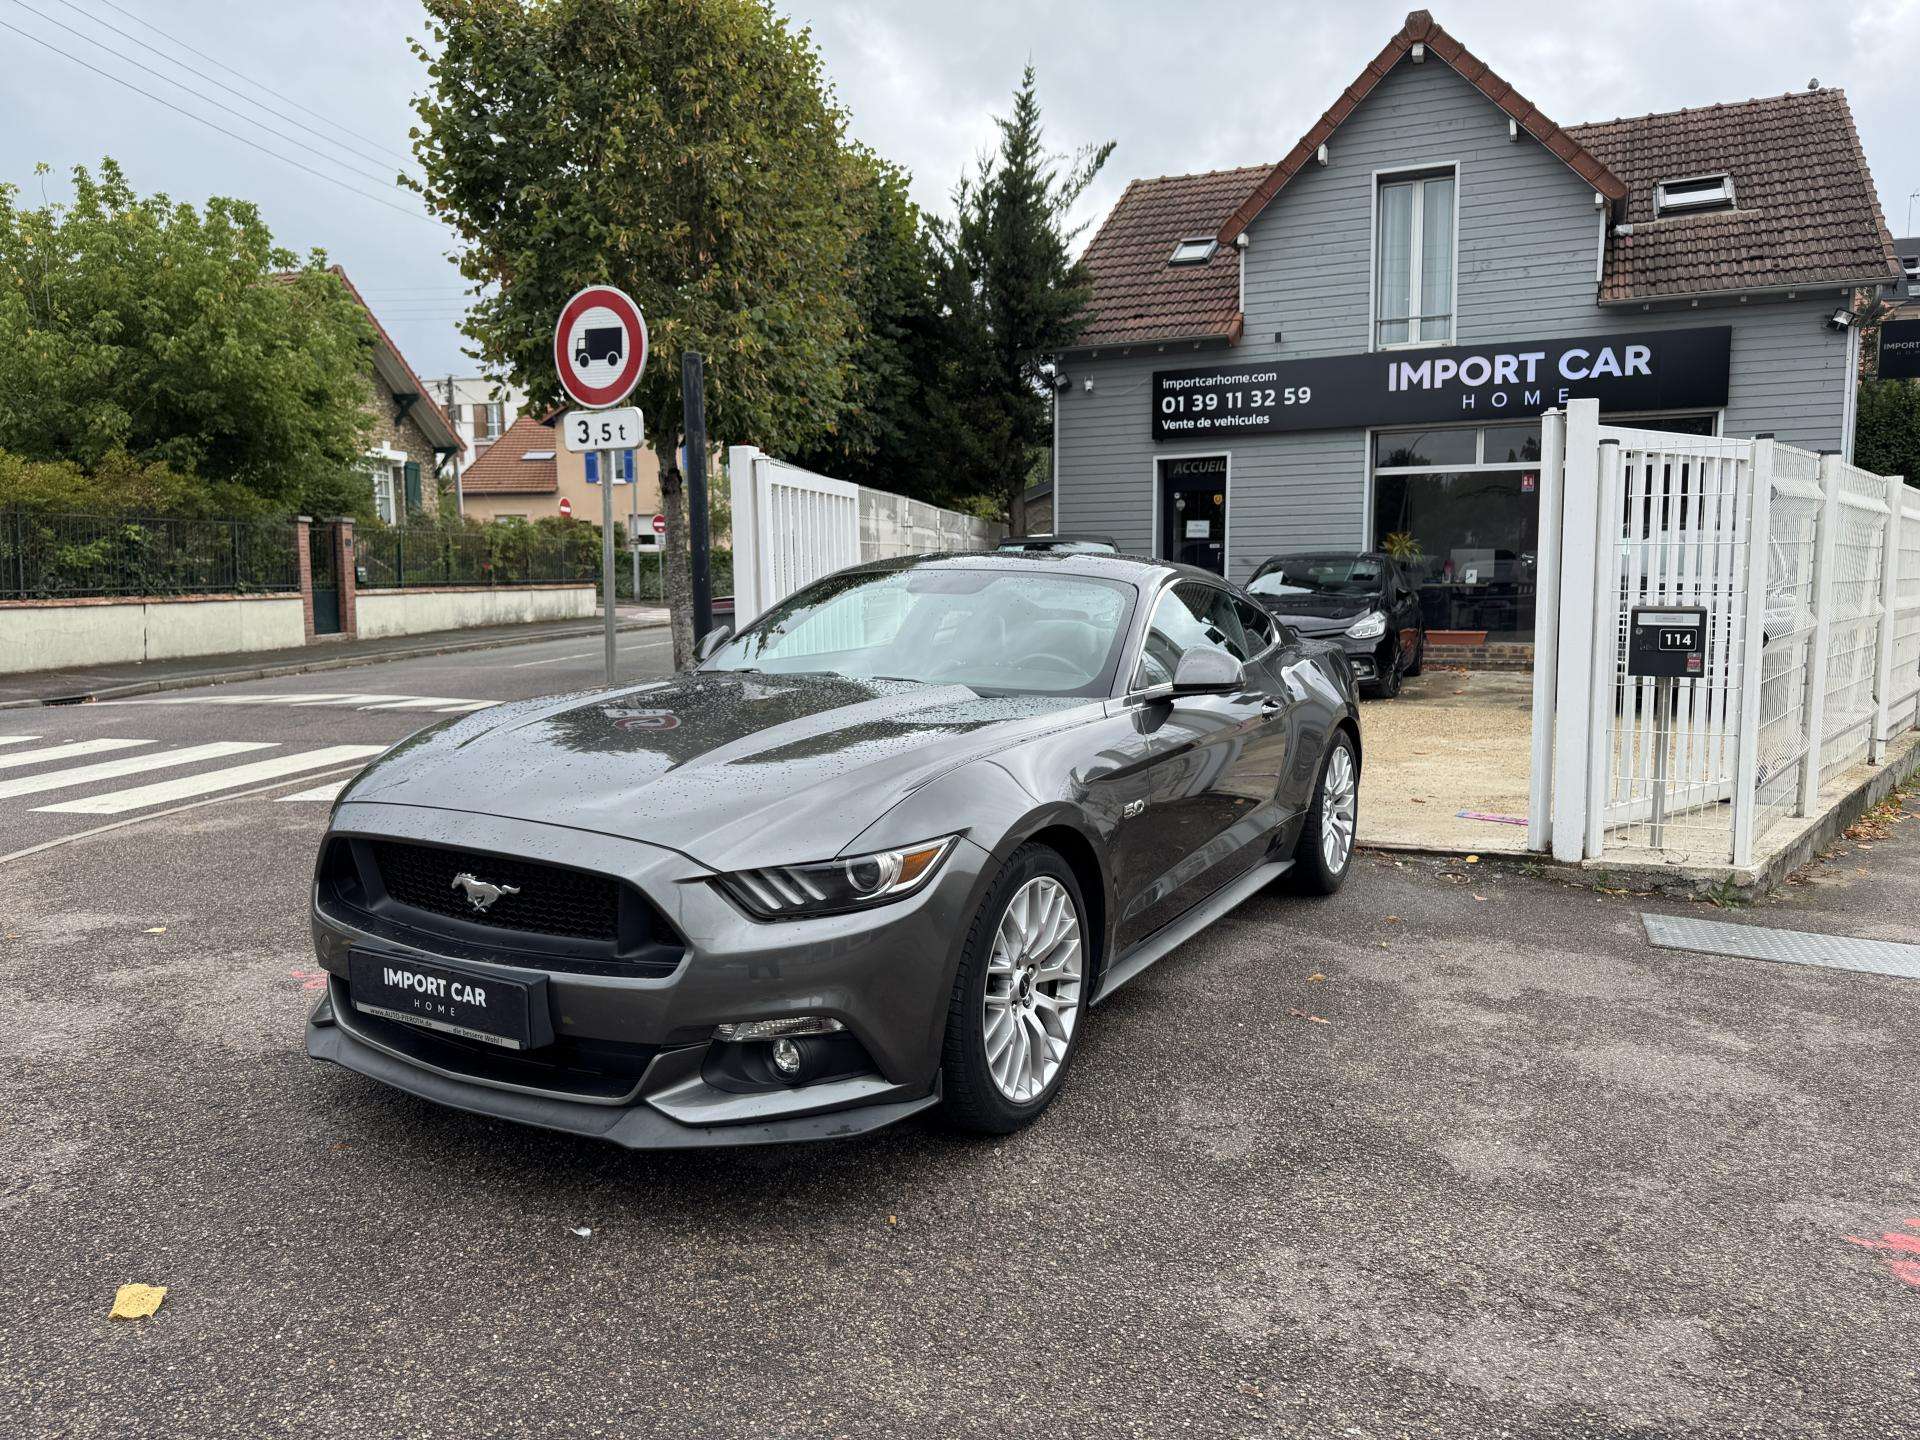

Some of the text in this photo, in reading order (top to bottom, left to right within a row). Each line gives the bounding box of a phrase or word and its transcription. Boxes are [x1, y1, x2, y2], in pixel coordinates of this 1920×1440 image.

[1884, 342, 1920, 350] IMPORT
[1388, 345, 1652, 392] IMPORT CAR
[1162, 372, 1277, 391] importcarhome.com
[1161, 386, 1311, 414] 01 39 11 32 59
[1462, 388, 1570, 410] HOME
[1162, 414, 1270, 430] Vente de vehicules
[577, 420, 626, 446] 3,5 t
[1173, 460, 1226, 474] ACCUEIL
[1665, 633, 1692, 646] 114
[383, 967, 487, 1007] IMPORT CAR
[414, 999, 455, 1016] HOME
[463, 1028, 484, 1041] bessere
